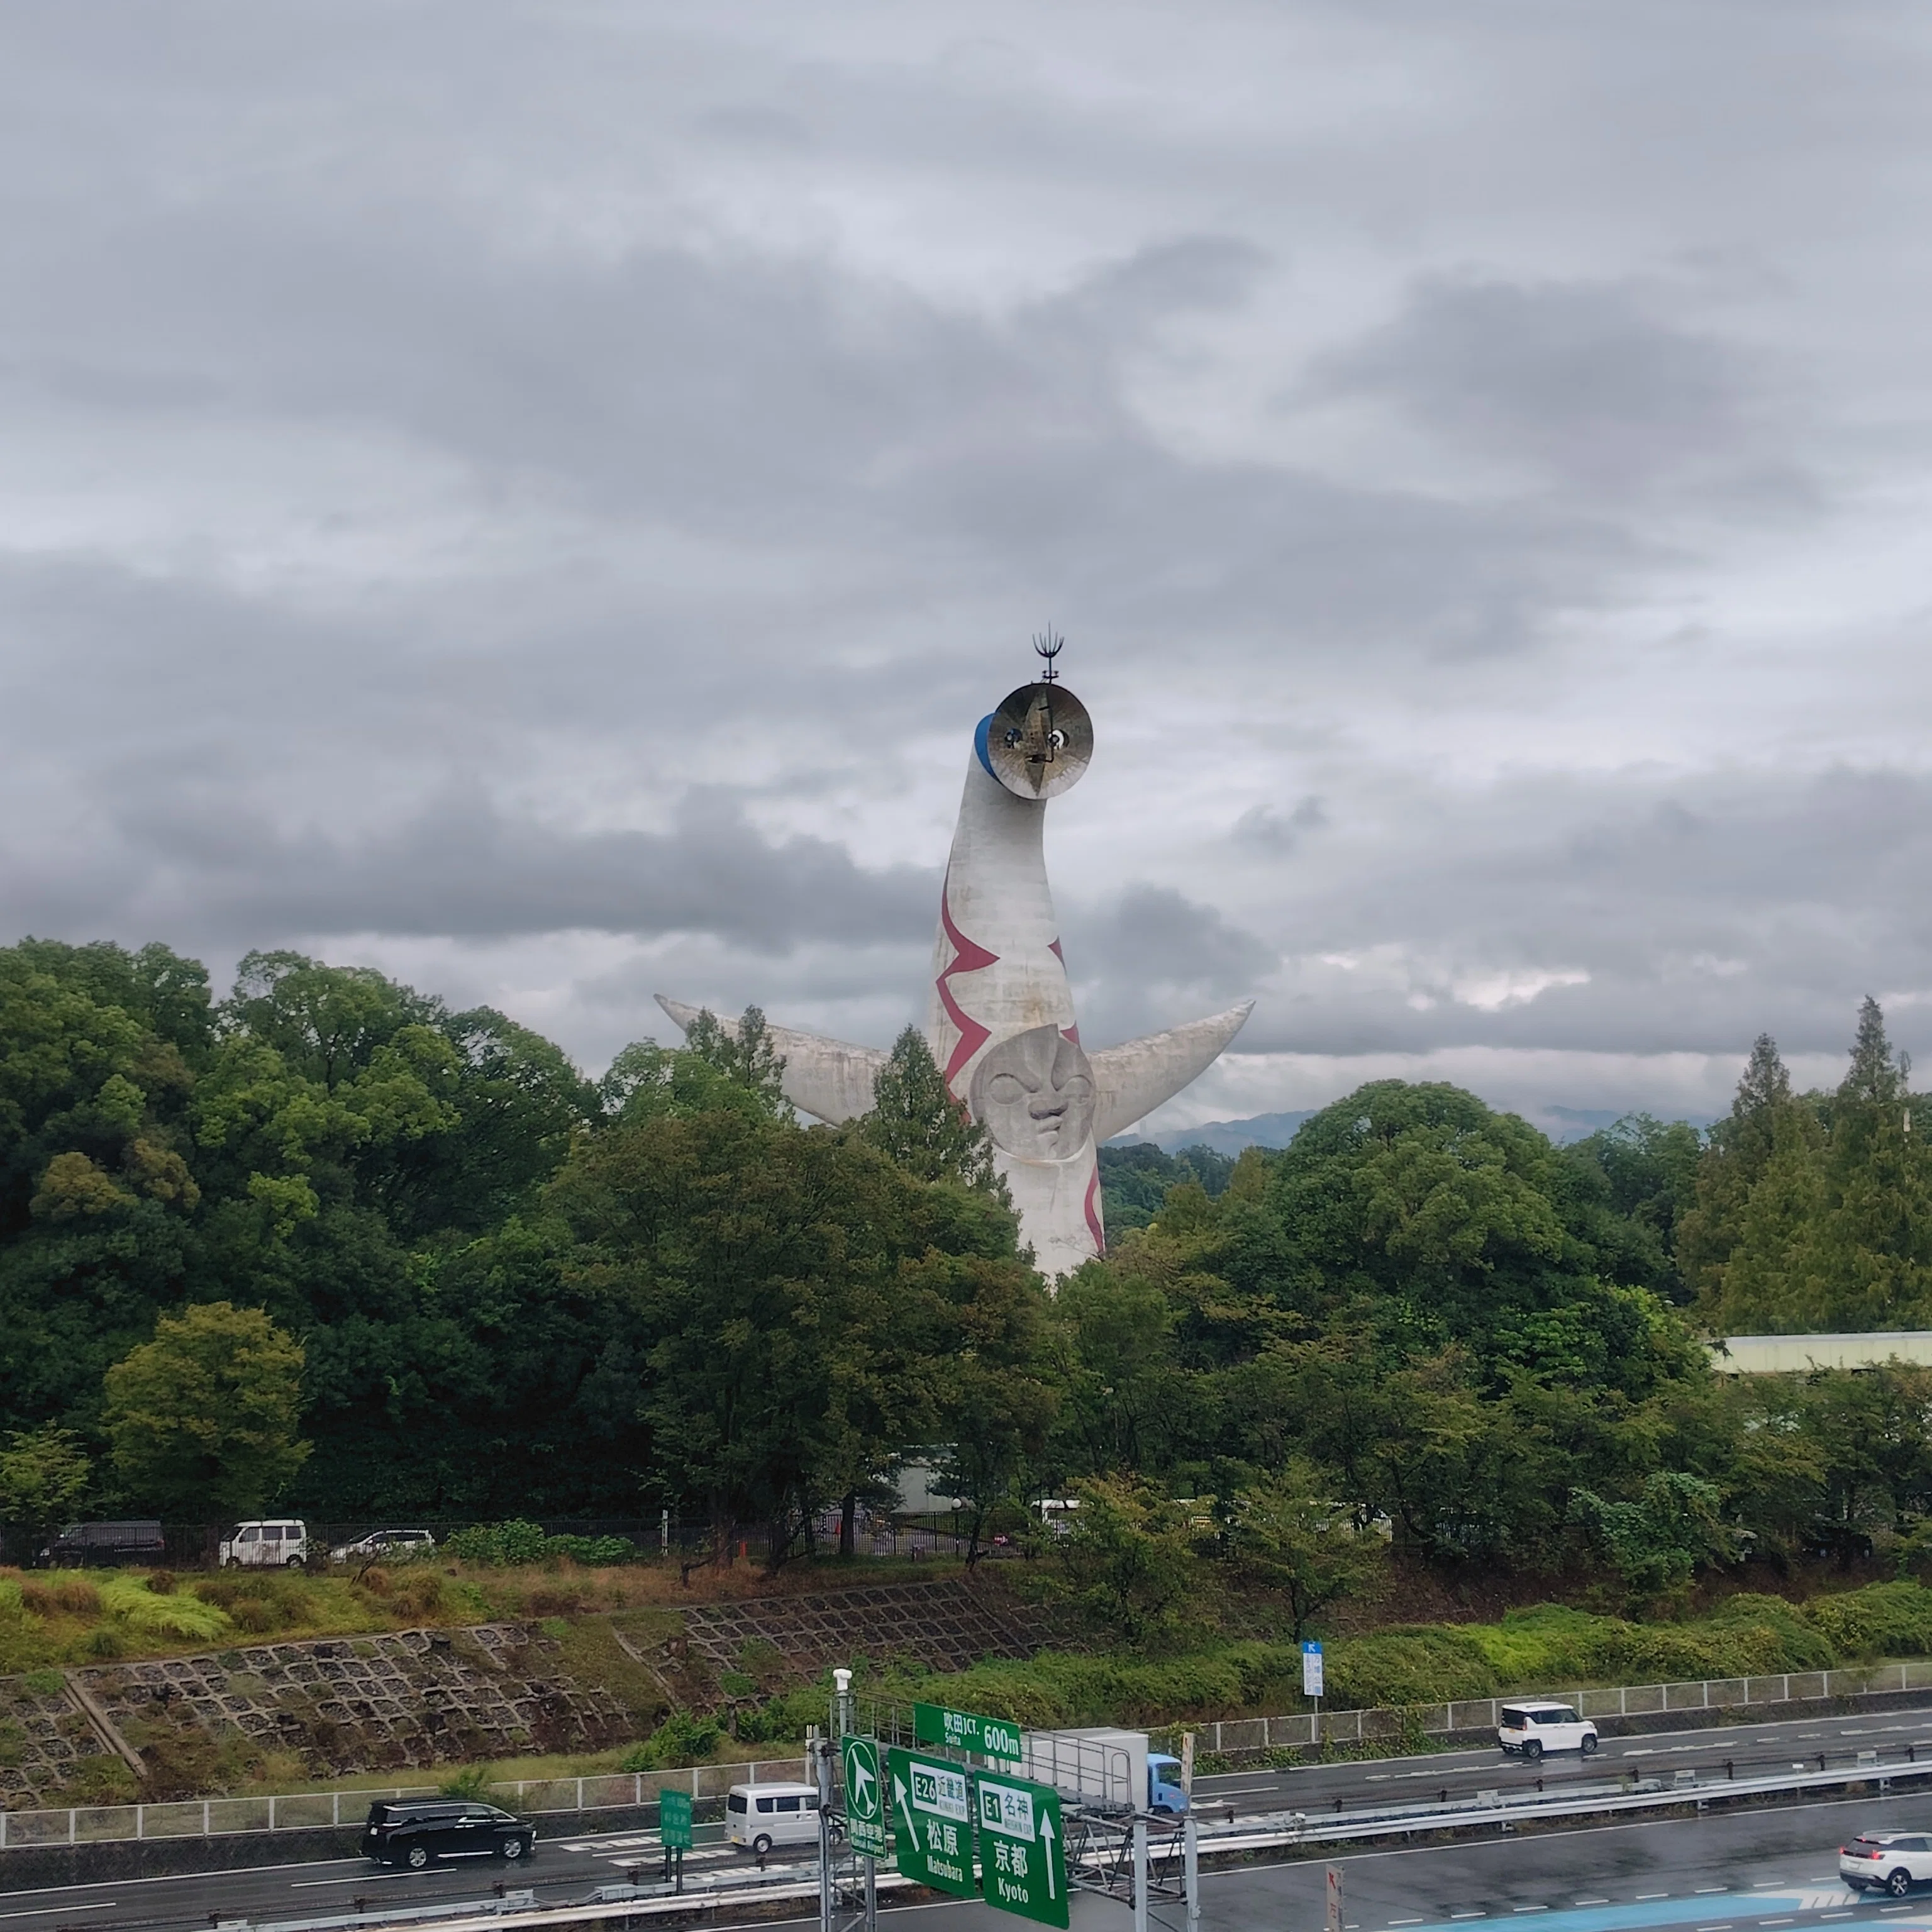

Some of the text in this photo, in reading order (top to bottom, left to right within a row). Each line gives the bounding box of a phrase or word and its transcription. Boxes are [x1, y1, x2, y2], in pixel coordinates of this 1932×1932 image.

[984, 1725, 1019, 1756] 600m
[914, 1776, 936, 1800] E26
[937, 1775, 964, 1802] 近畿道
[985, 1796, 999, 1818] E1
[1004, 1792, 1028, 1821] 名神
[926, 1819, 958, 1856] 松原
[927, 1855, 963, 1882] Matsubara
[994, 1840, 1028, 1878] 京都
[998, 1877, 1028, 1903] Kyoto
